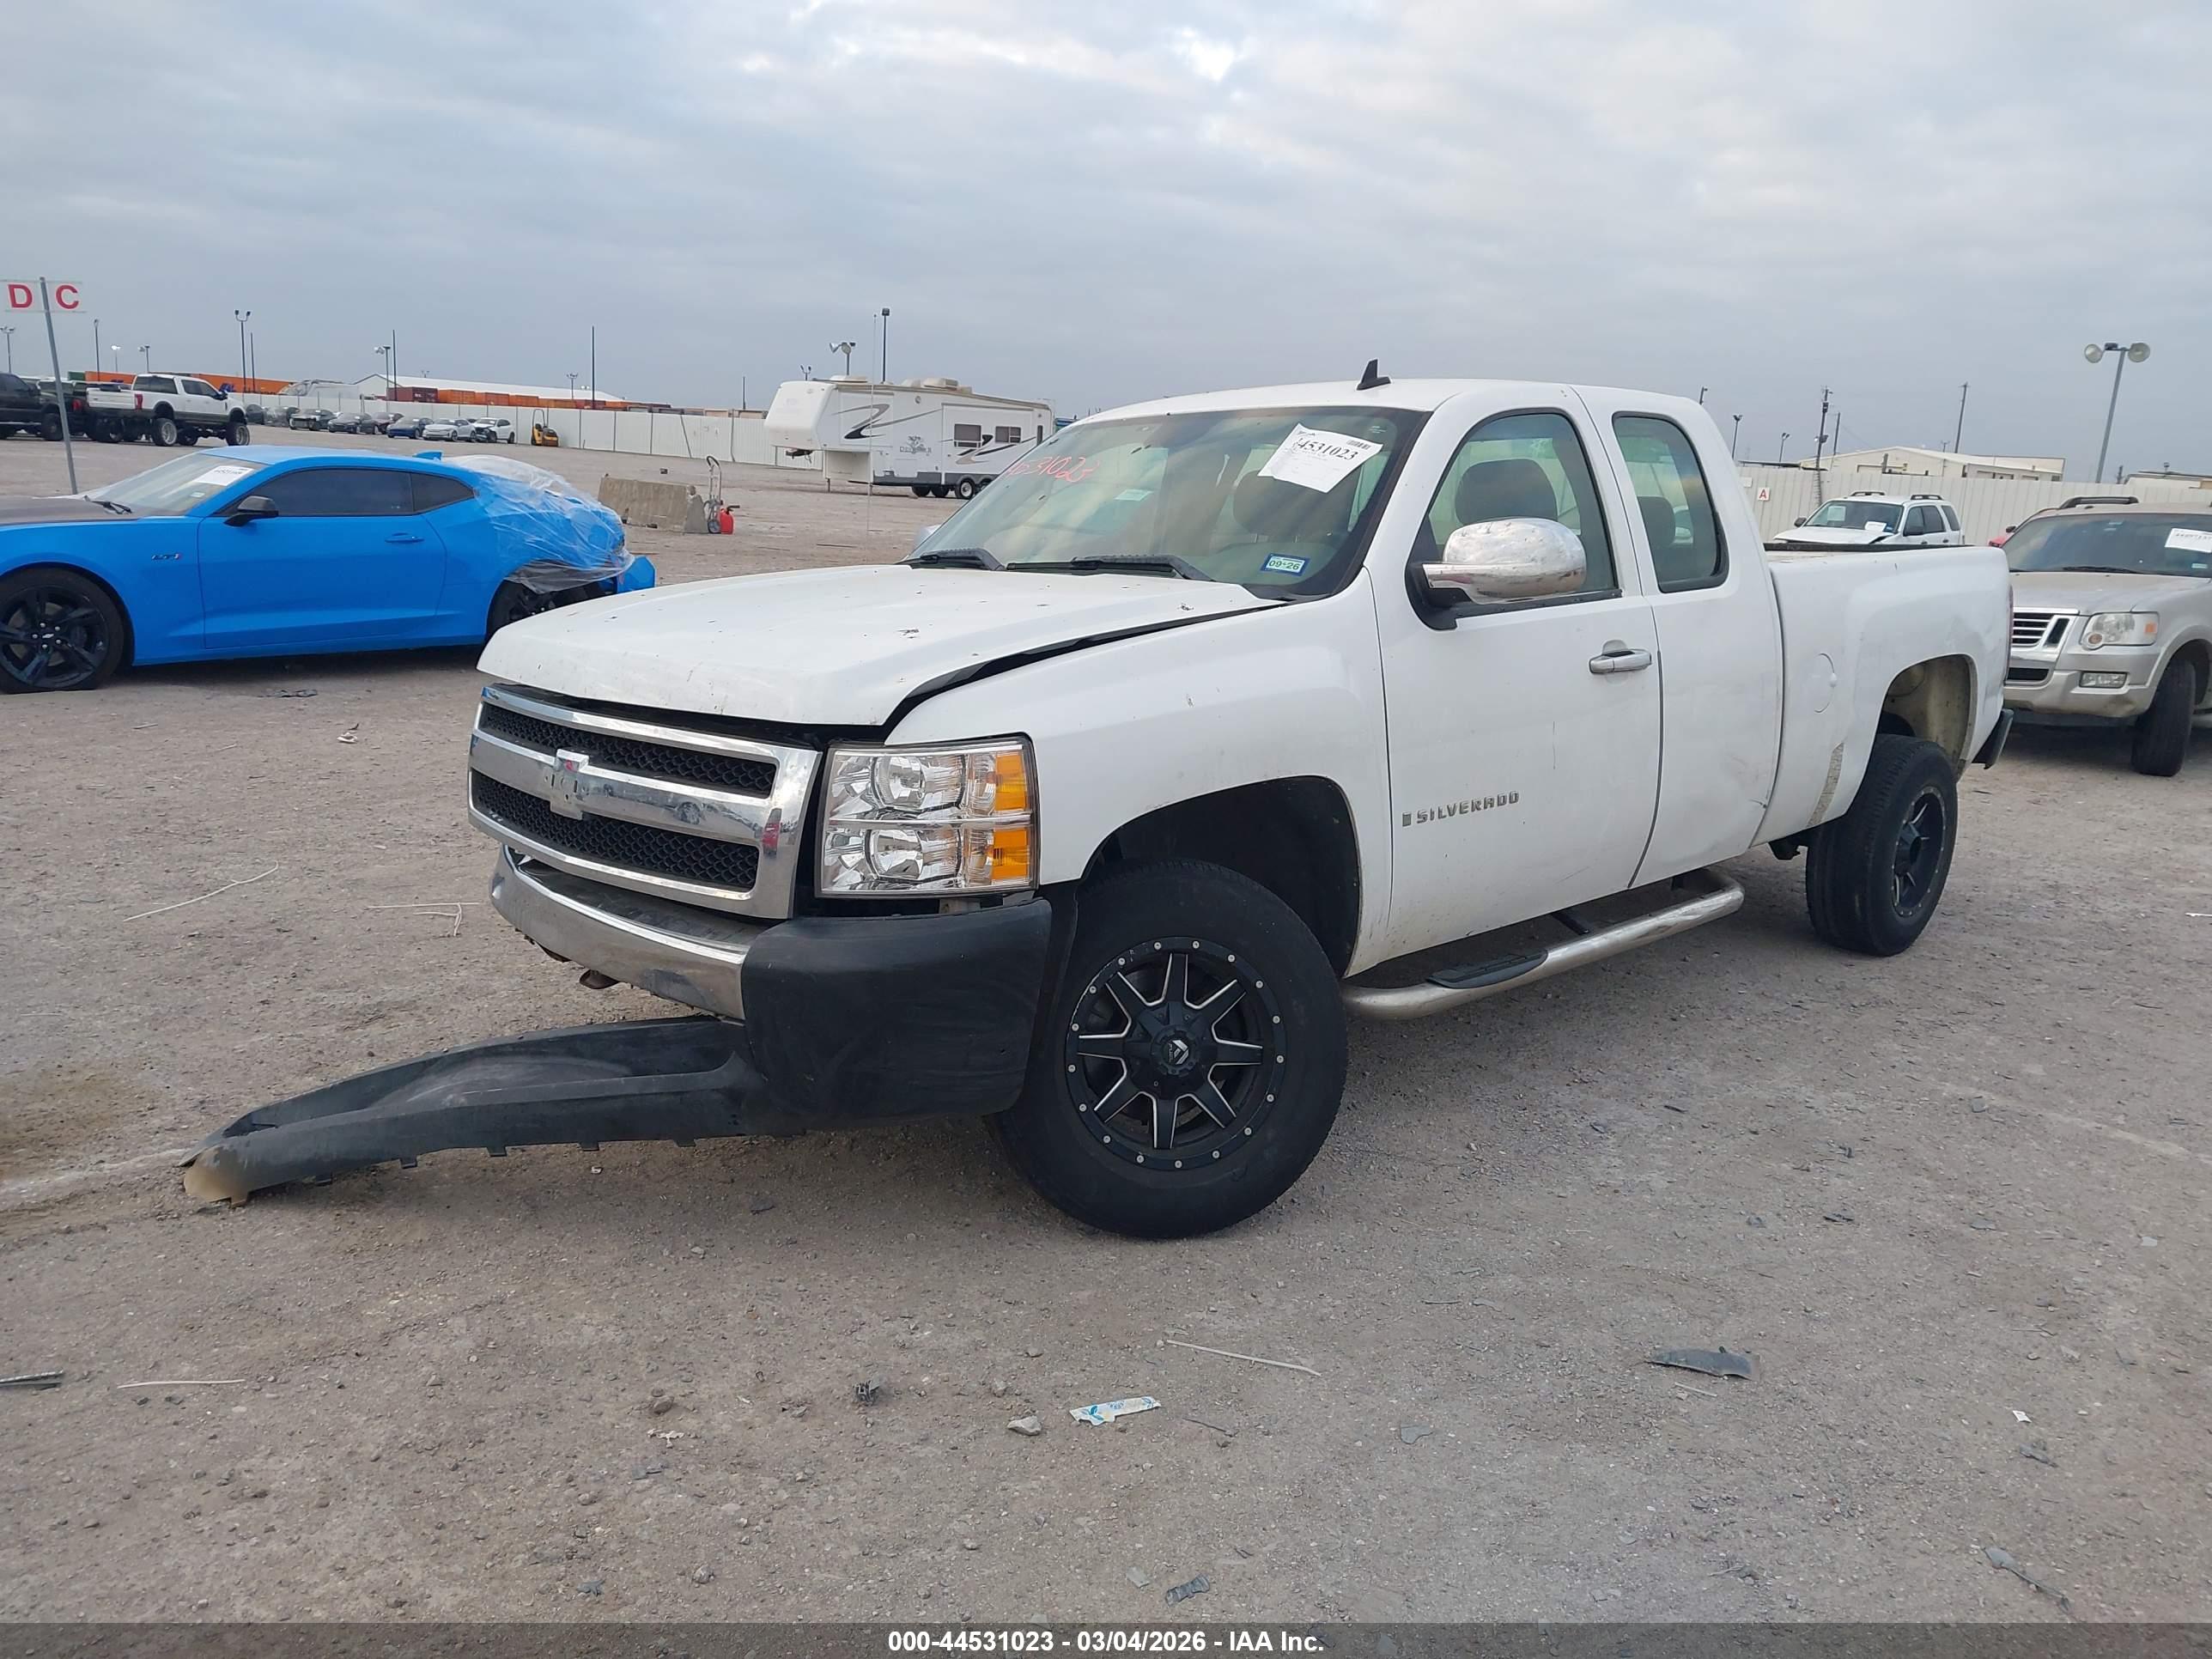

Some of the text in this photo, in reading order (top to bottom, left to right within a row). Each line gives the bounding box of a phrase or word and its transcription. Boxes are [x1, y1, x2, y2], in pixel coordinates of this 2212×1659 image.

[8, 284, 33, 307] D
[56, 284, 78, 309] C
[1759, 489, 1767, 499] A
[1417, 791, 1519, 823] SILVERADO
